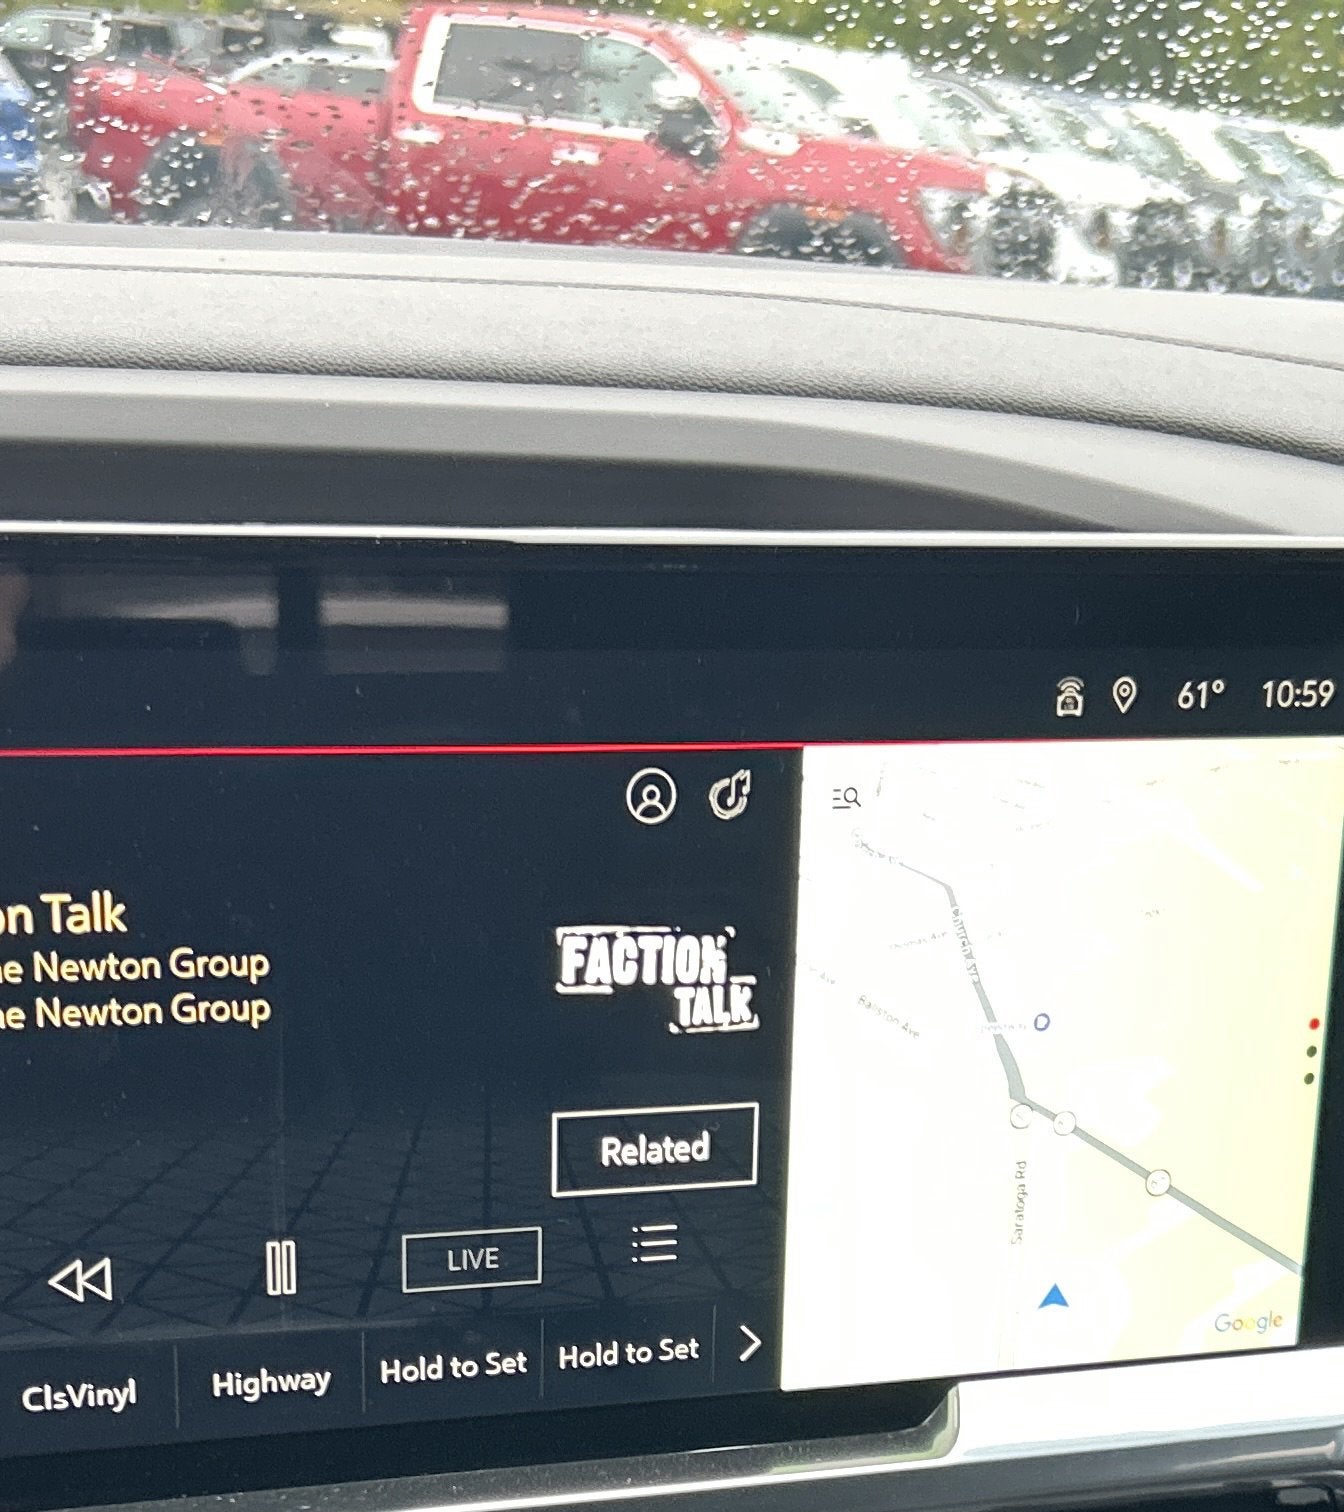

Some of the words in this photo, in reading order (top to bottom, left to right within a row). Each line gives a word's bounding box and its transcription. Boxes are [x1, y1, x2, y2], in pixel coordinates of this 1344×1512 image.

[1178, 680, 1224, 708] 61°
[1263, 680, 1334, 707] 10:59
[40, 890, 127, 934] Talk
[34, 951, 161, 982] Newton
[170, 947, 269, 984] Group
[561, 934, 728, 986] FACTION
[36, 997, 163, 1027] Newton
[171, 993, 271, 1029] Group
[673, 984, 753, 1026] TALK
[602, 1130, 710, 1166] Related
[448, 1248, 499, 1271] LIVE
[1214, 1310, 1283, 1334] Google
[381, 1355, 442, 1383] Hold
[450, 1357, 478, 1377] to
[485, 1352, 527, 1375] Set
[560, 1341, 618, 1369] Hold
[625, 1343, 652, 1363] to
[659, 1338, 699, 1360] Set
[22, 1378, 136, 1412] ClsVinyl
[213, 1368, 331, 1402] Highway
